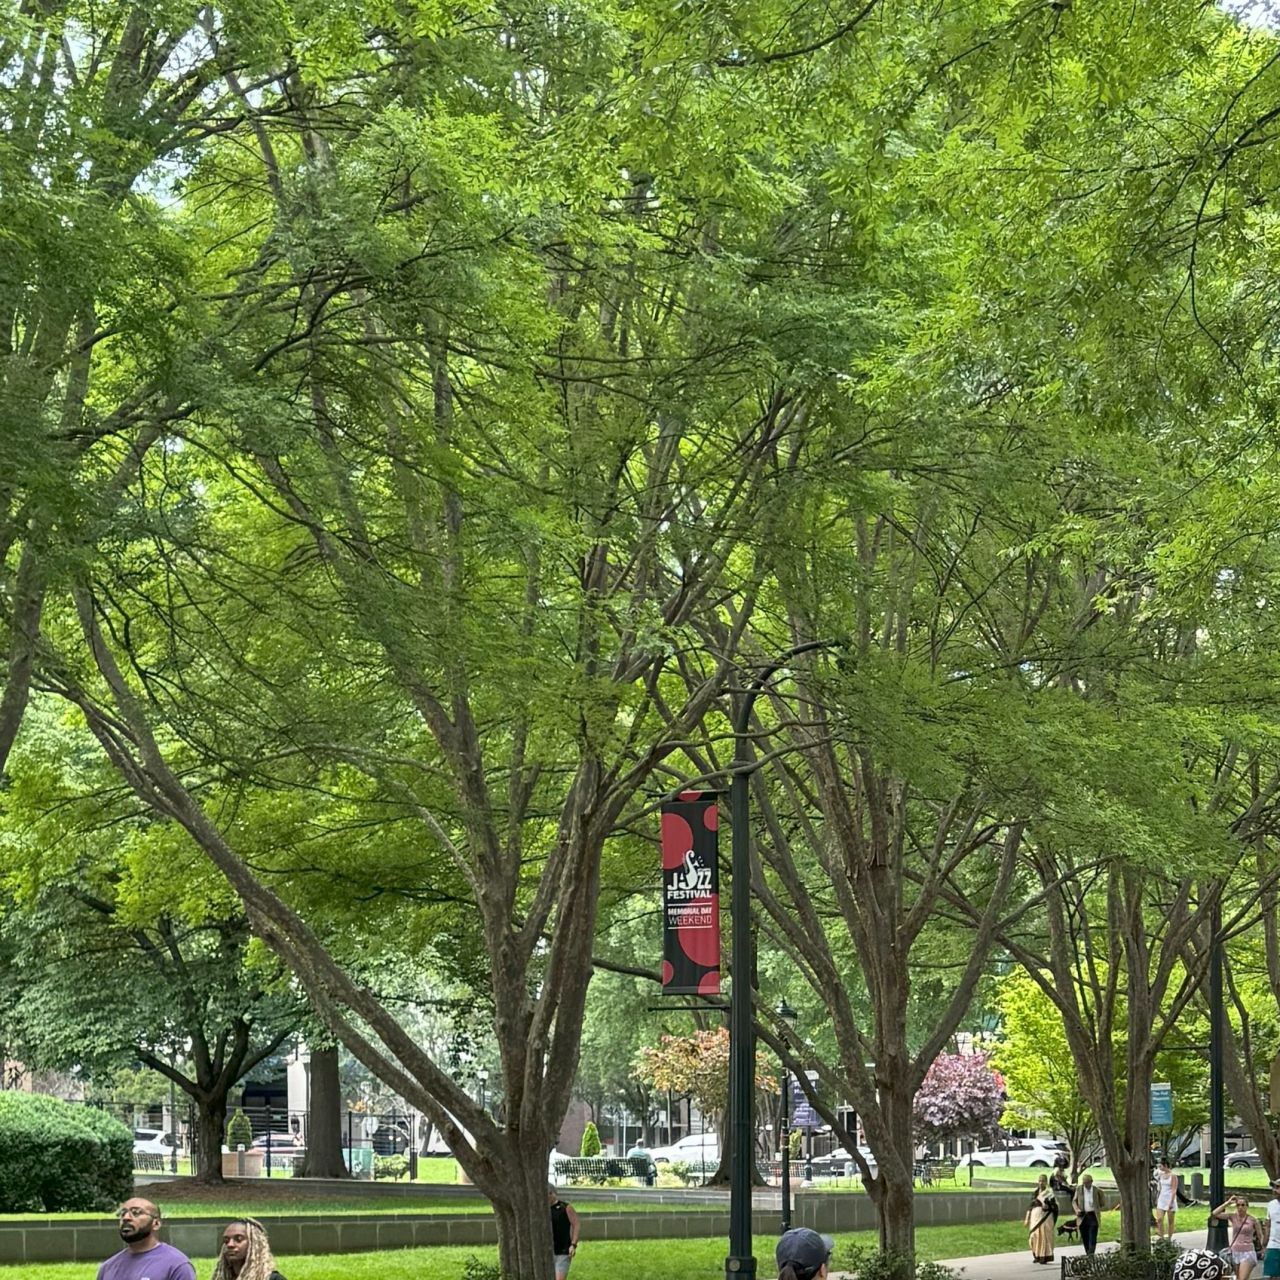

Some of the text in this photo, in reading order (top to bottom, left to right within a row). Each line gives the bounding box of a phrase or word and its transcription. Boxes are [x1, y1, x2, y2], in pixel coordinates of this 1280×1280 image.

[667, 867, 712, 890] JAZZ
[667, 890, 712, 900] FESTIVAL
[667, 906, 712, 915] MEMORIAL DAY
[668, 915, 712, 925] WEEKEND
